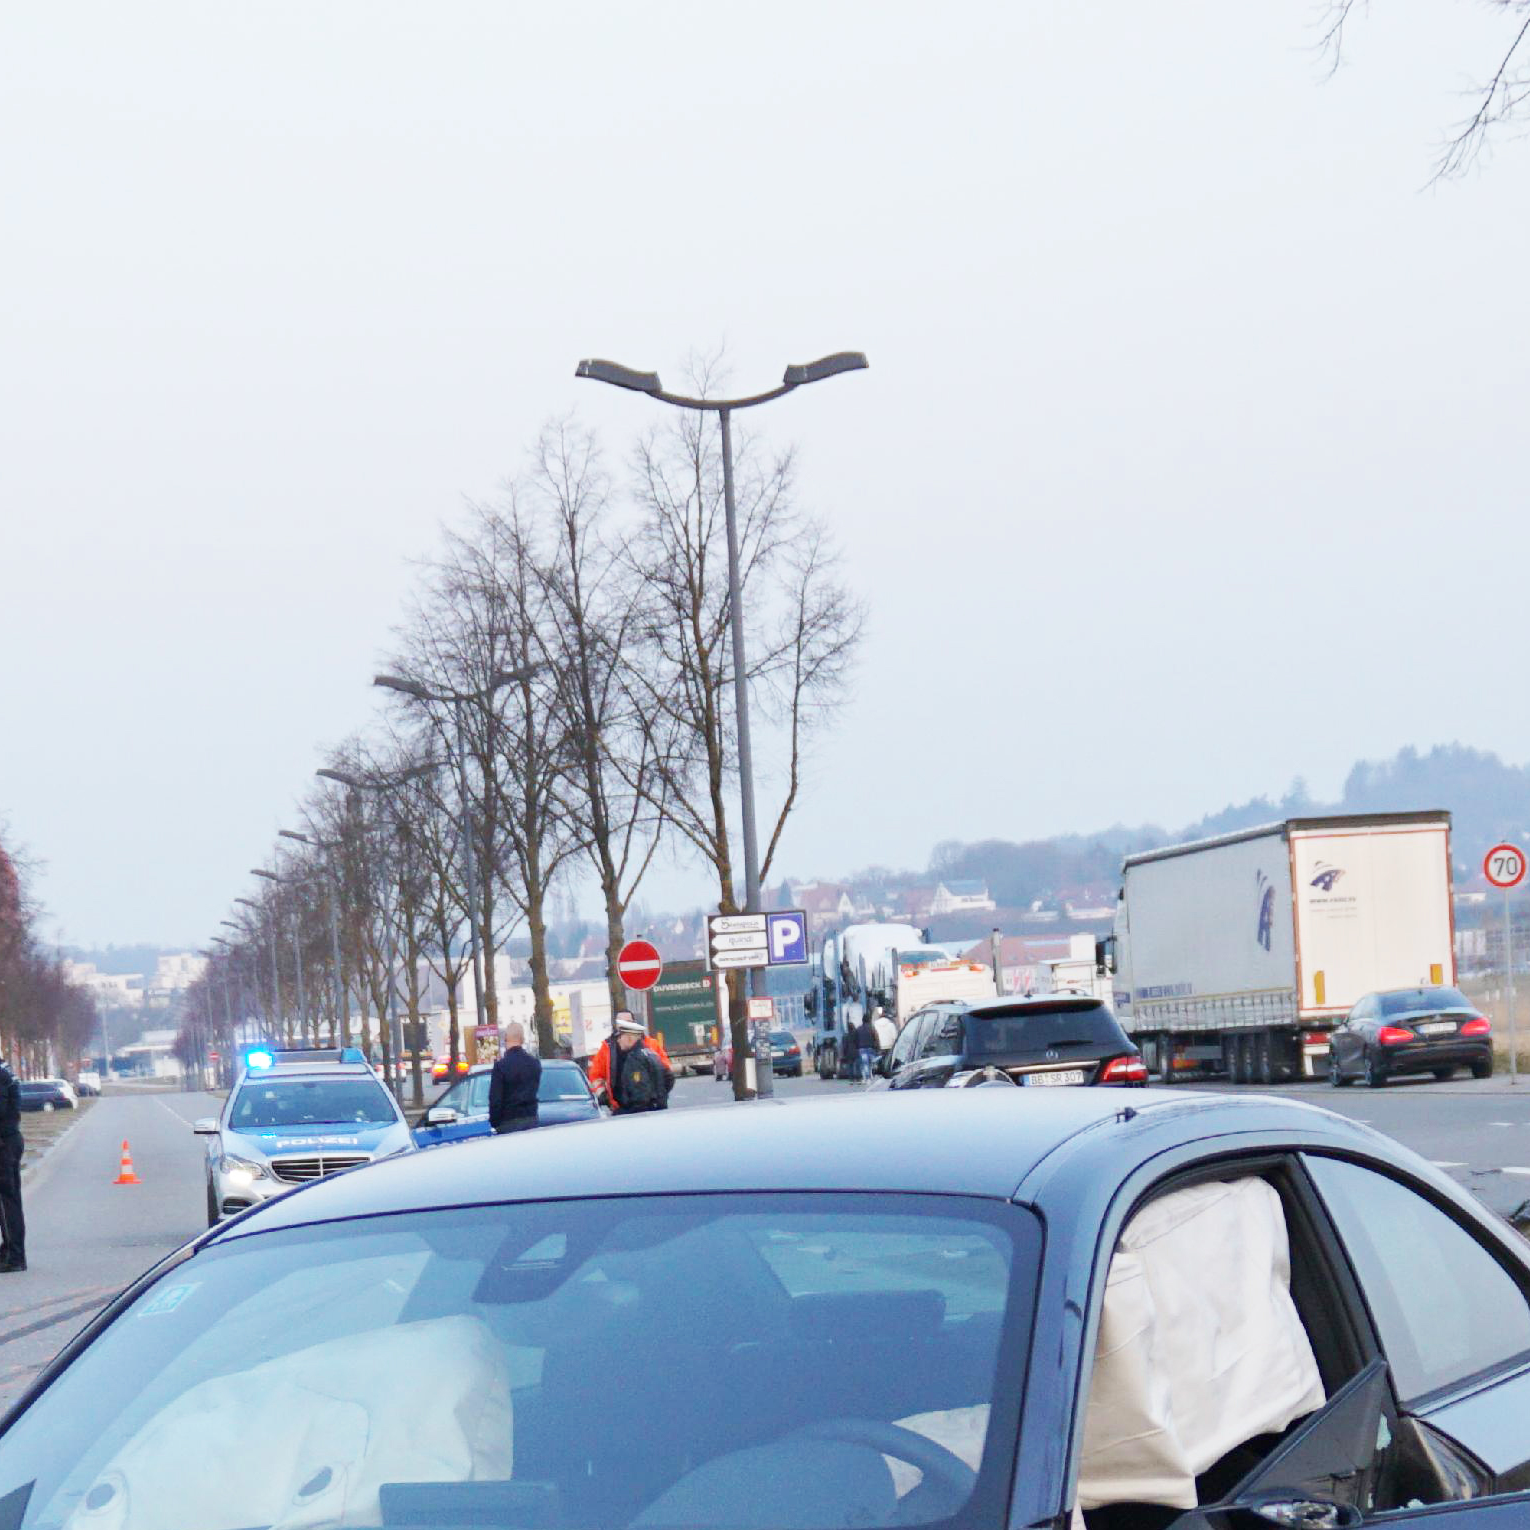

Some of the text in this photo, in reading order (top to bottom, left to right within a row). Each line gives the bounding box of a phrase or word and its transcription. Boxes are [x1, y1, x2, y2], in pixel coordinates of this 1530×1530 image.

[1494, 857, 1517, 876] 70
[773, 920, 800, 957] P
[277, 1137, 358, 1148] POLIZEI
